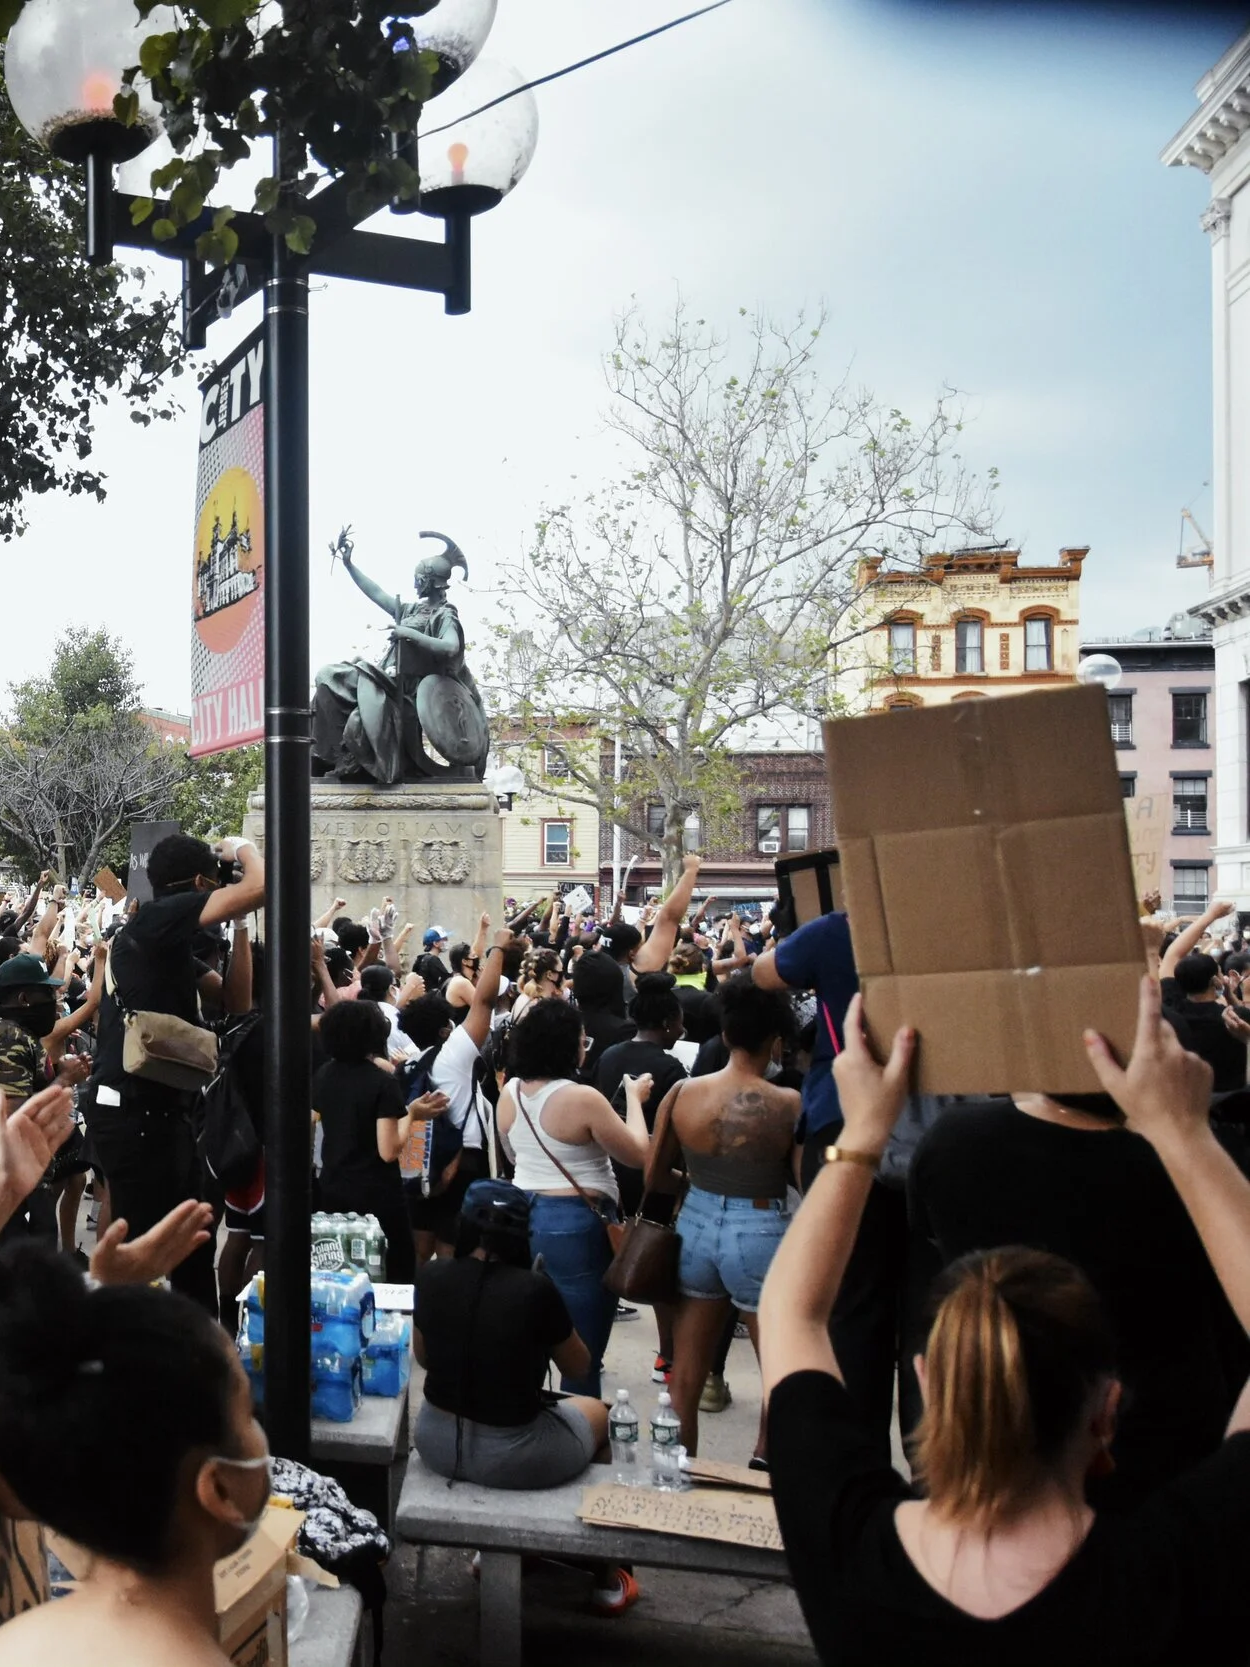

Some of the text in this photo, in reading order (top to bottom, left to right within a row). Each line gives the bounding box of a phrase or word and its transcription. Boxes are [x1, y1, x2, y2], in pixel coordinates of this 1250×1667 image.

[218, 375, 229, 428] JERSEY
[191, 690, 223, 747] CITY
[311, 1251, 344, 1269] Spring
